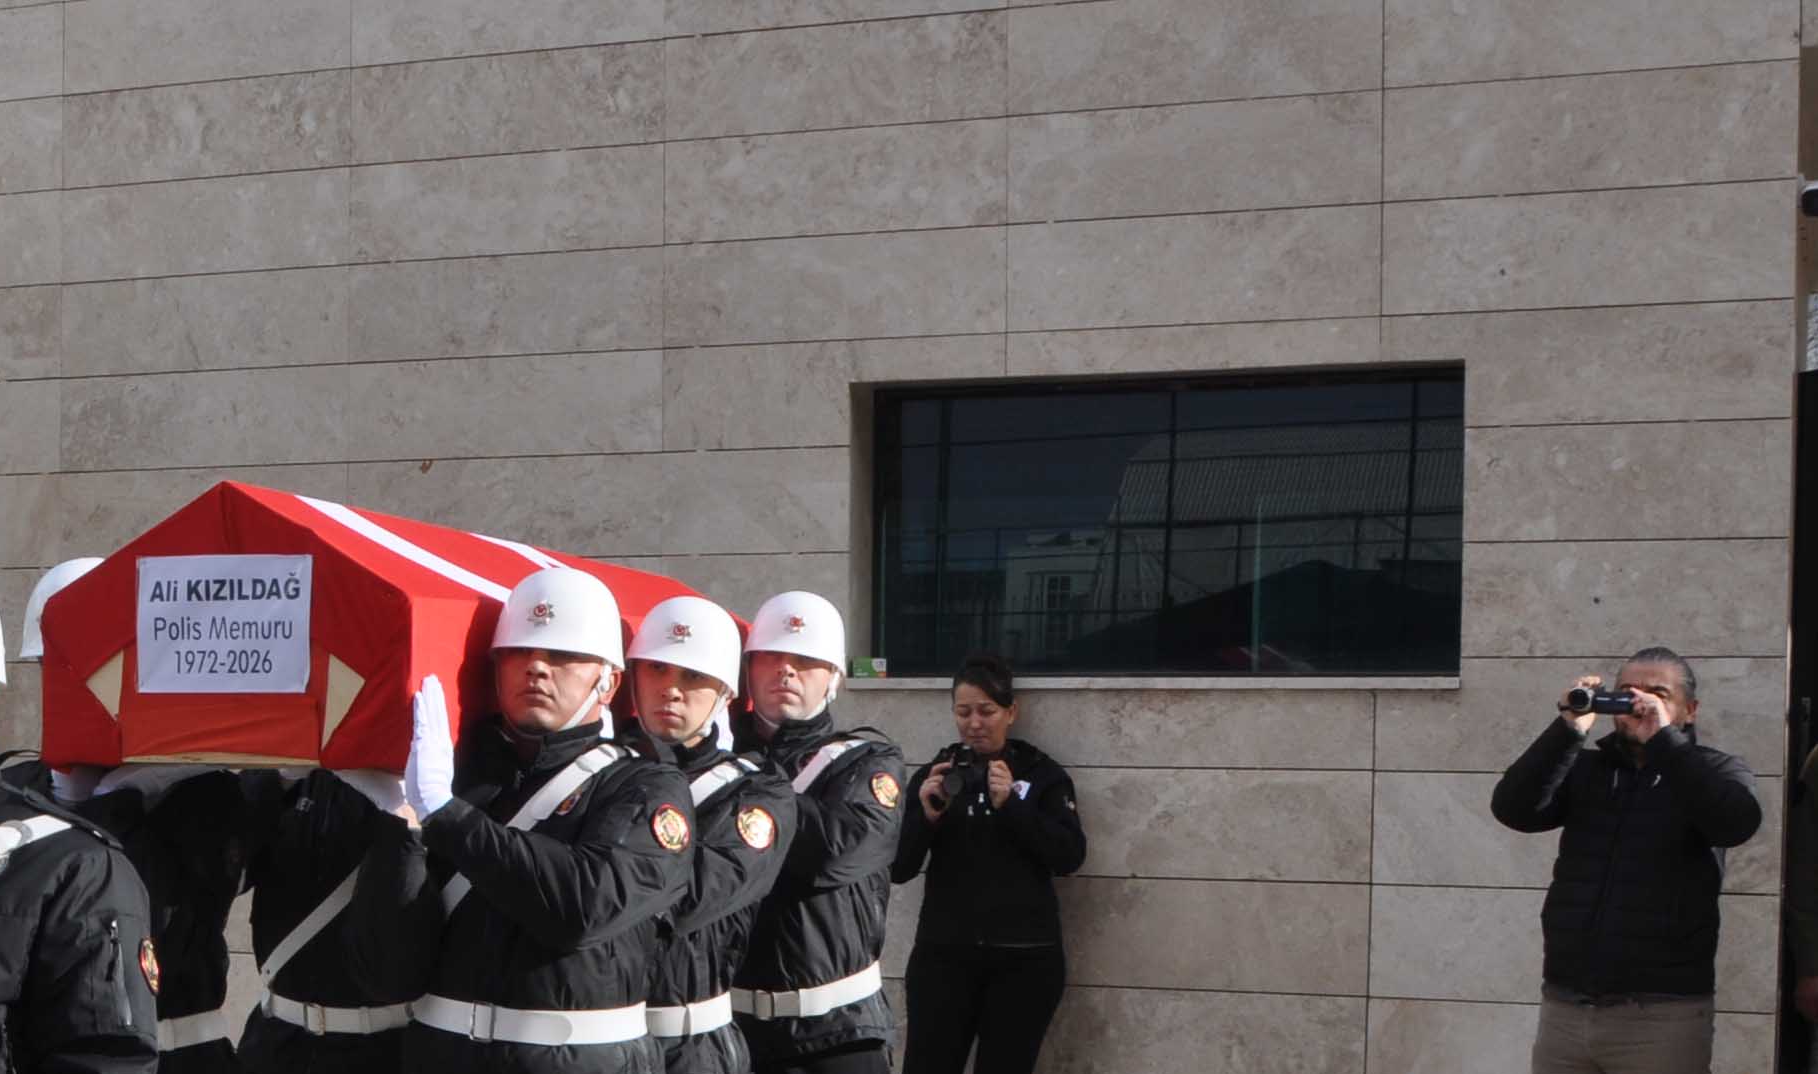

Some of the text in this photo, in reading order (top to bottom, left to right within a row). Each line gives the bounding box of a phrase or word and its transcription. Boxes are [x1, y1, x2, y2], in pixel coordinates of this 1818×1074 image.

[149, 571, 301, 602] Ali KIZILDAĞ
[153, 616, 293, 641] Polis Memuru
[175, 650, 273, 674] 1972-2026
